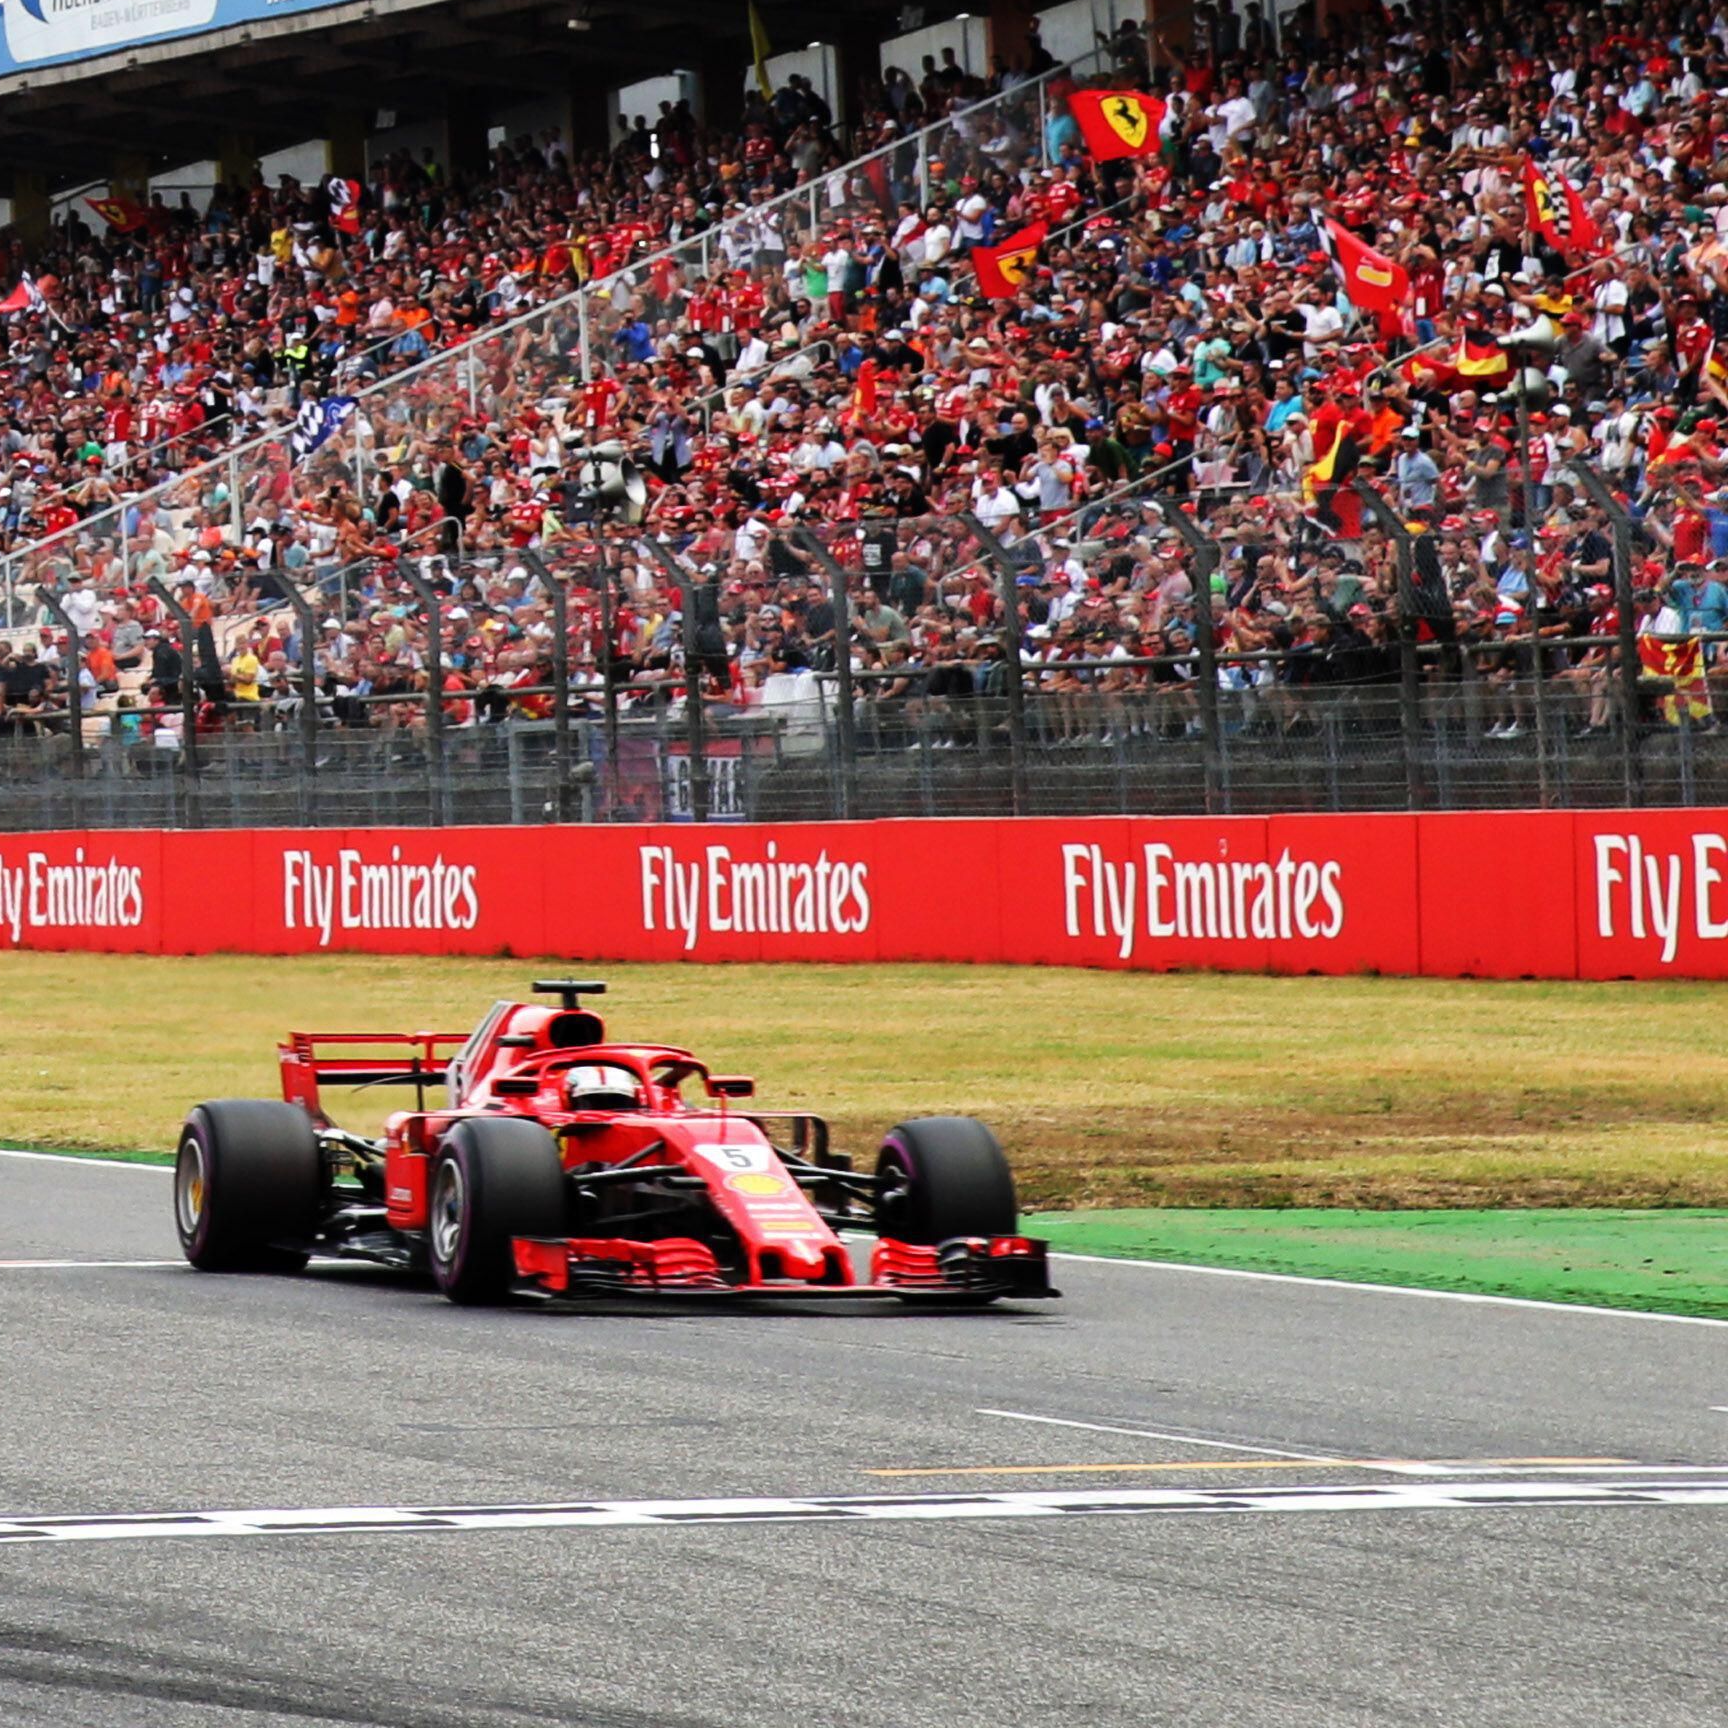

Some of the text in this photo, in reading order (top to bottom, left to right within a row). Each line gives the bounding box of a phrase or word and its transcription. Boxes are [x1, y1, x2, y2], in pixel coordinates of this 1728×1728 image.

[29, 847, 143, 927] Emirates
[284, 845, 478, 946] Fly Emirates
[640, 840, 870, 950] Fly Emirates
[1062, 839, 1343, 959] Fly Emirates
[1594, 834, 1681, 963] Fly
[721, 1148, 753, 1168] 5
